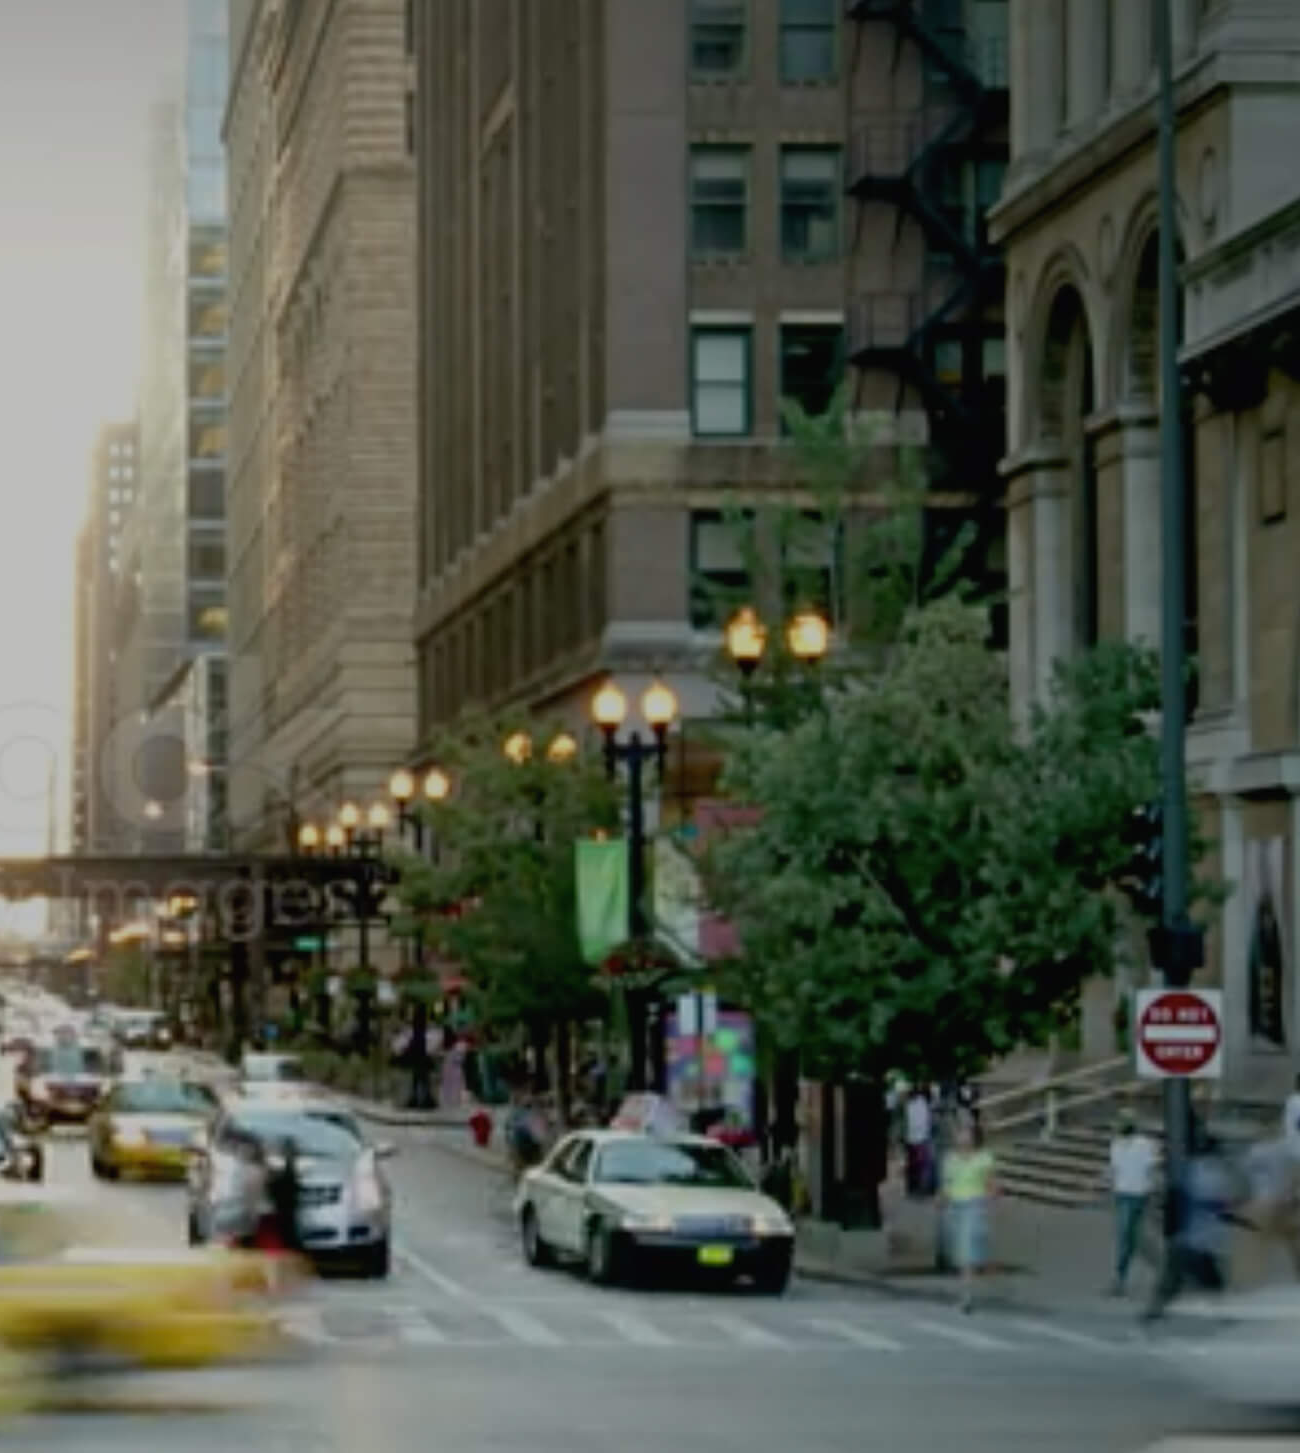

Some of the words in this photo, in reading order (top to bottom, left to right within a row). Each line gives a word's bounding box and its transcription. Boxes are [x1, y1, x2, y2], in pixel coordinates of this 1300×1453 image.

[1148, 1007, 1173, 1021] DO
[1177, 1007, 1209, 1021] NOT
[1154, 1045, 1204, 1060] ENTER
